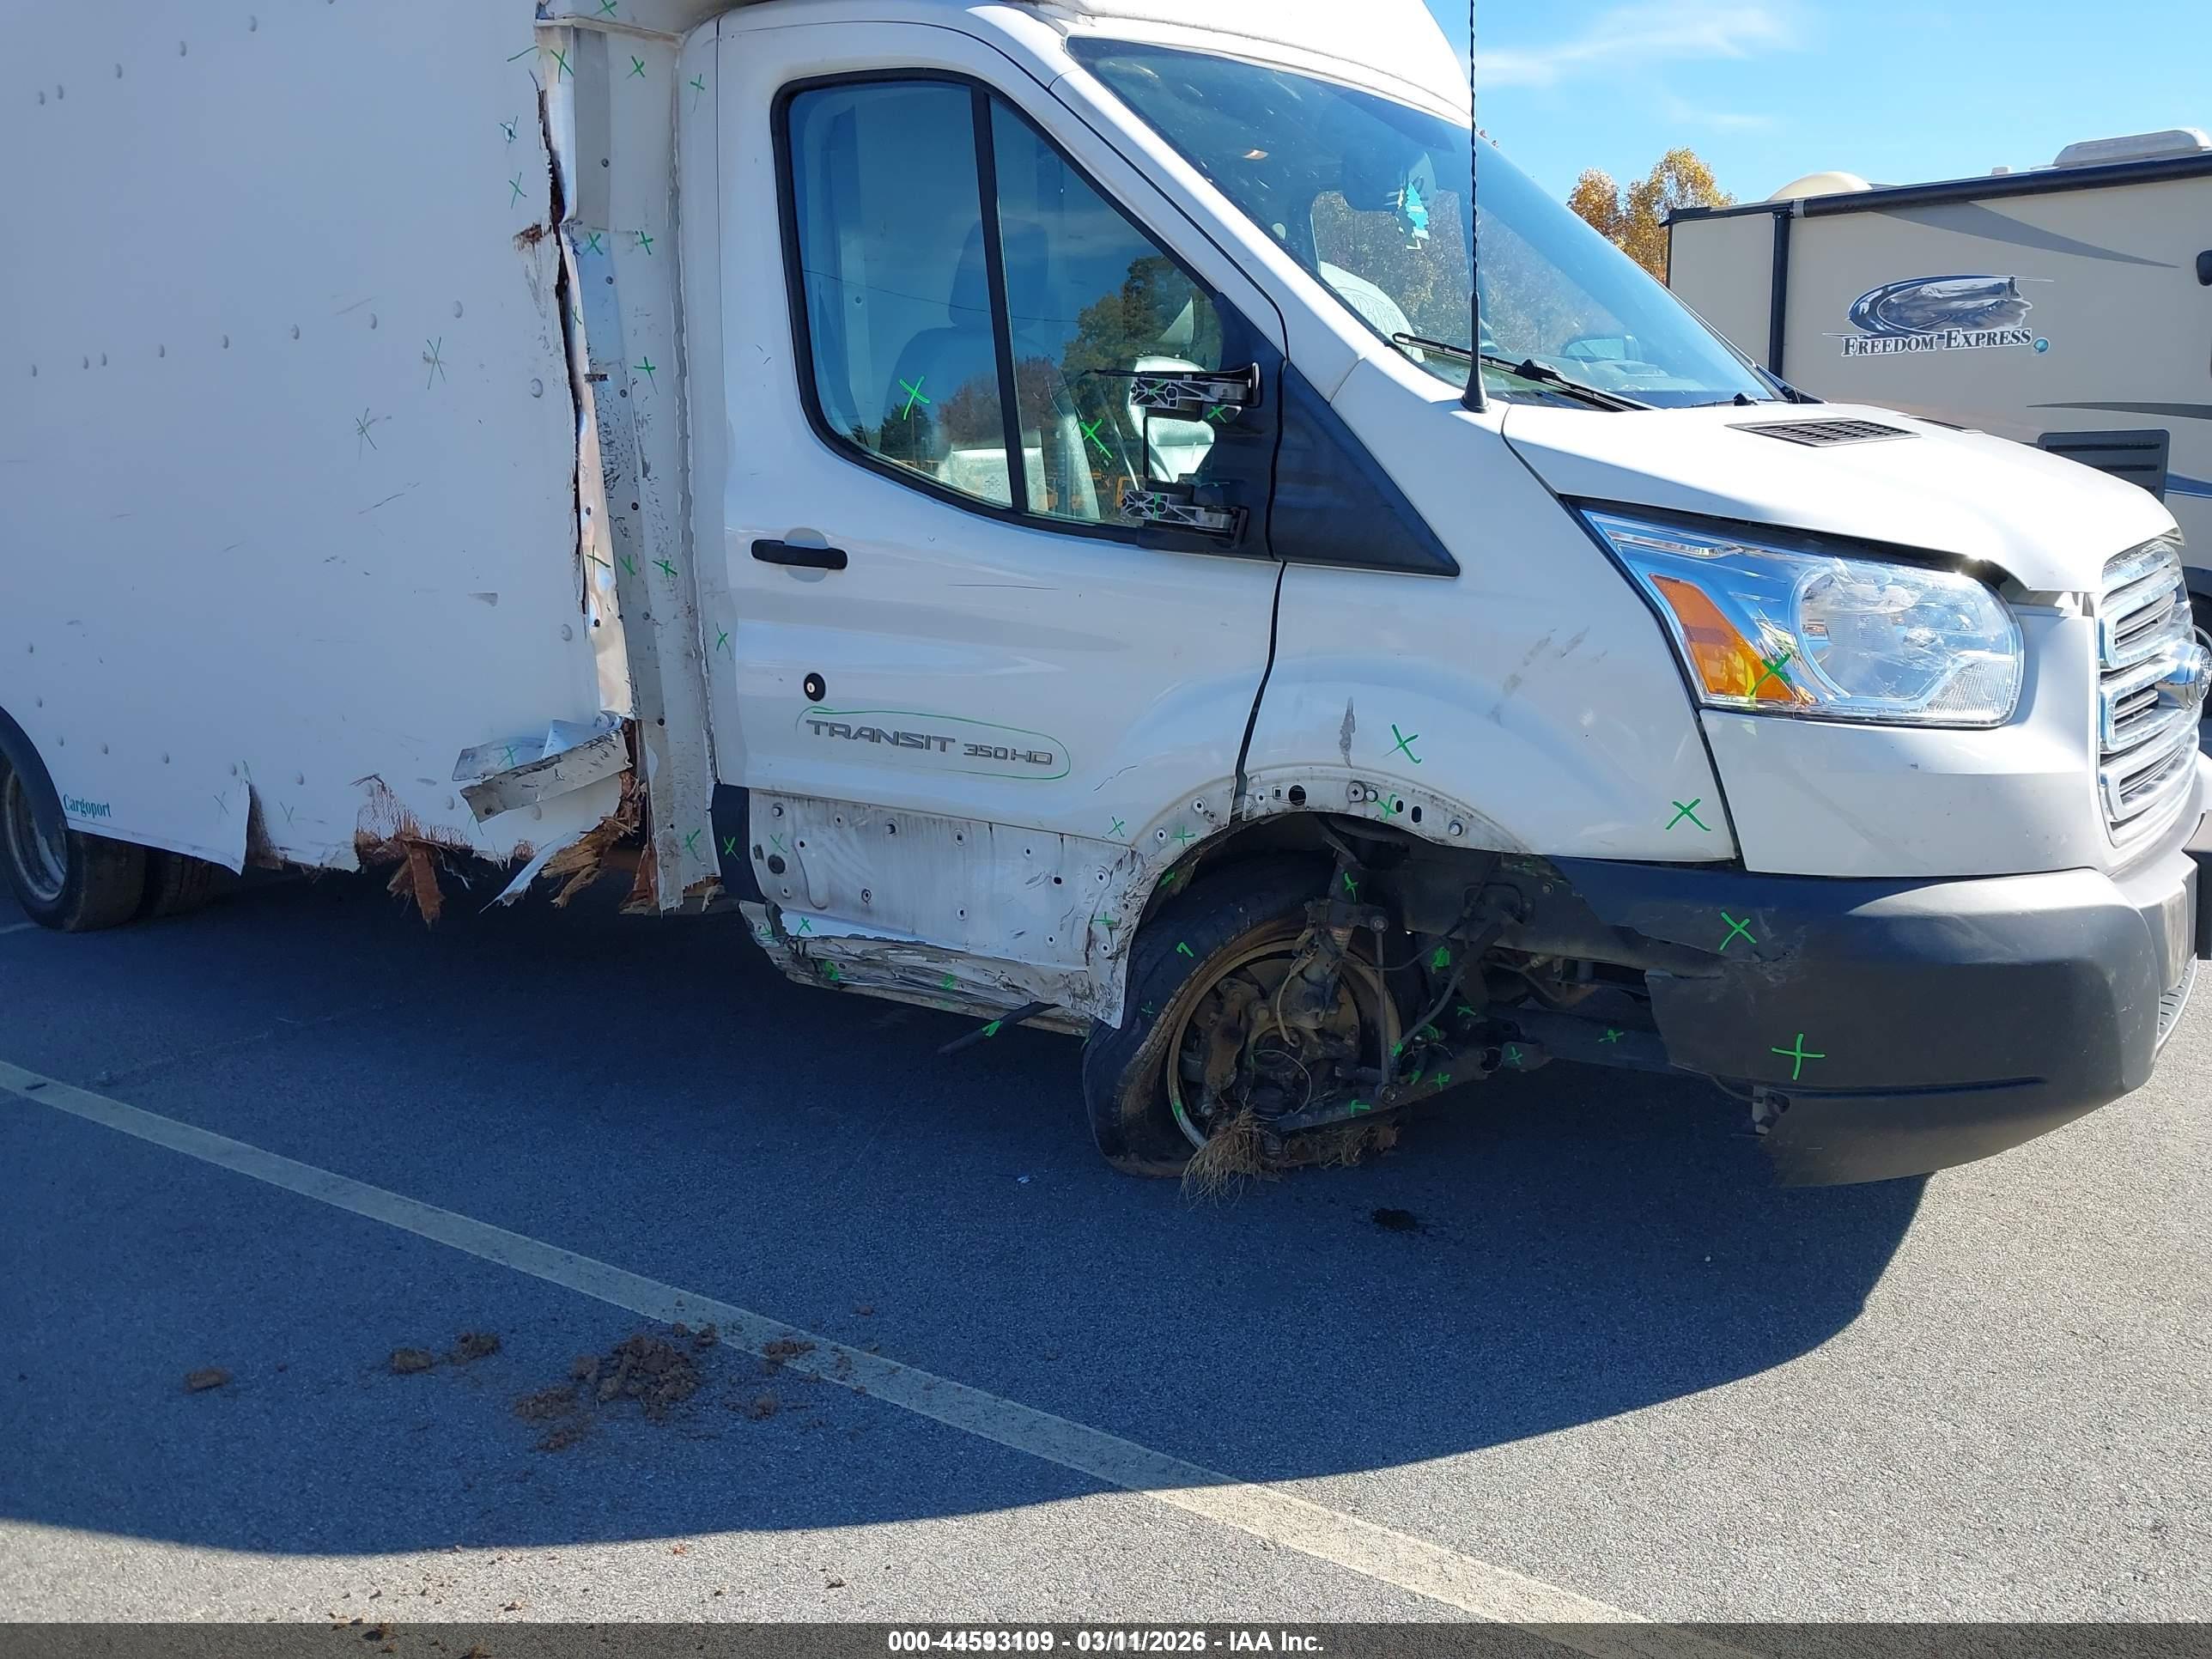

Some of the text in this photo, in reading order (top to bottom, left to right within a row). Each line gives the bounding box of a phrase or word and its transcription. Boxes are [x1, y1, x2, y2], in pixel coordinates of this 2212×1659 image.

[1843, 329, 2032, 356] FREEDOM EXPRESS
[805, 720, 956, 752] TRANSIT
[63, 793, 112, 818] Cargoport
